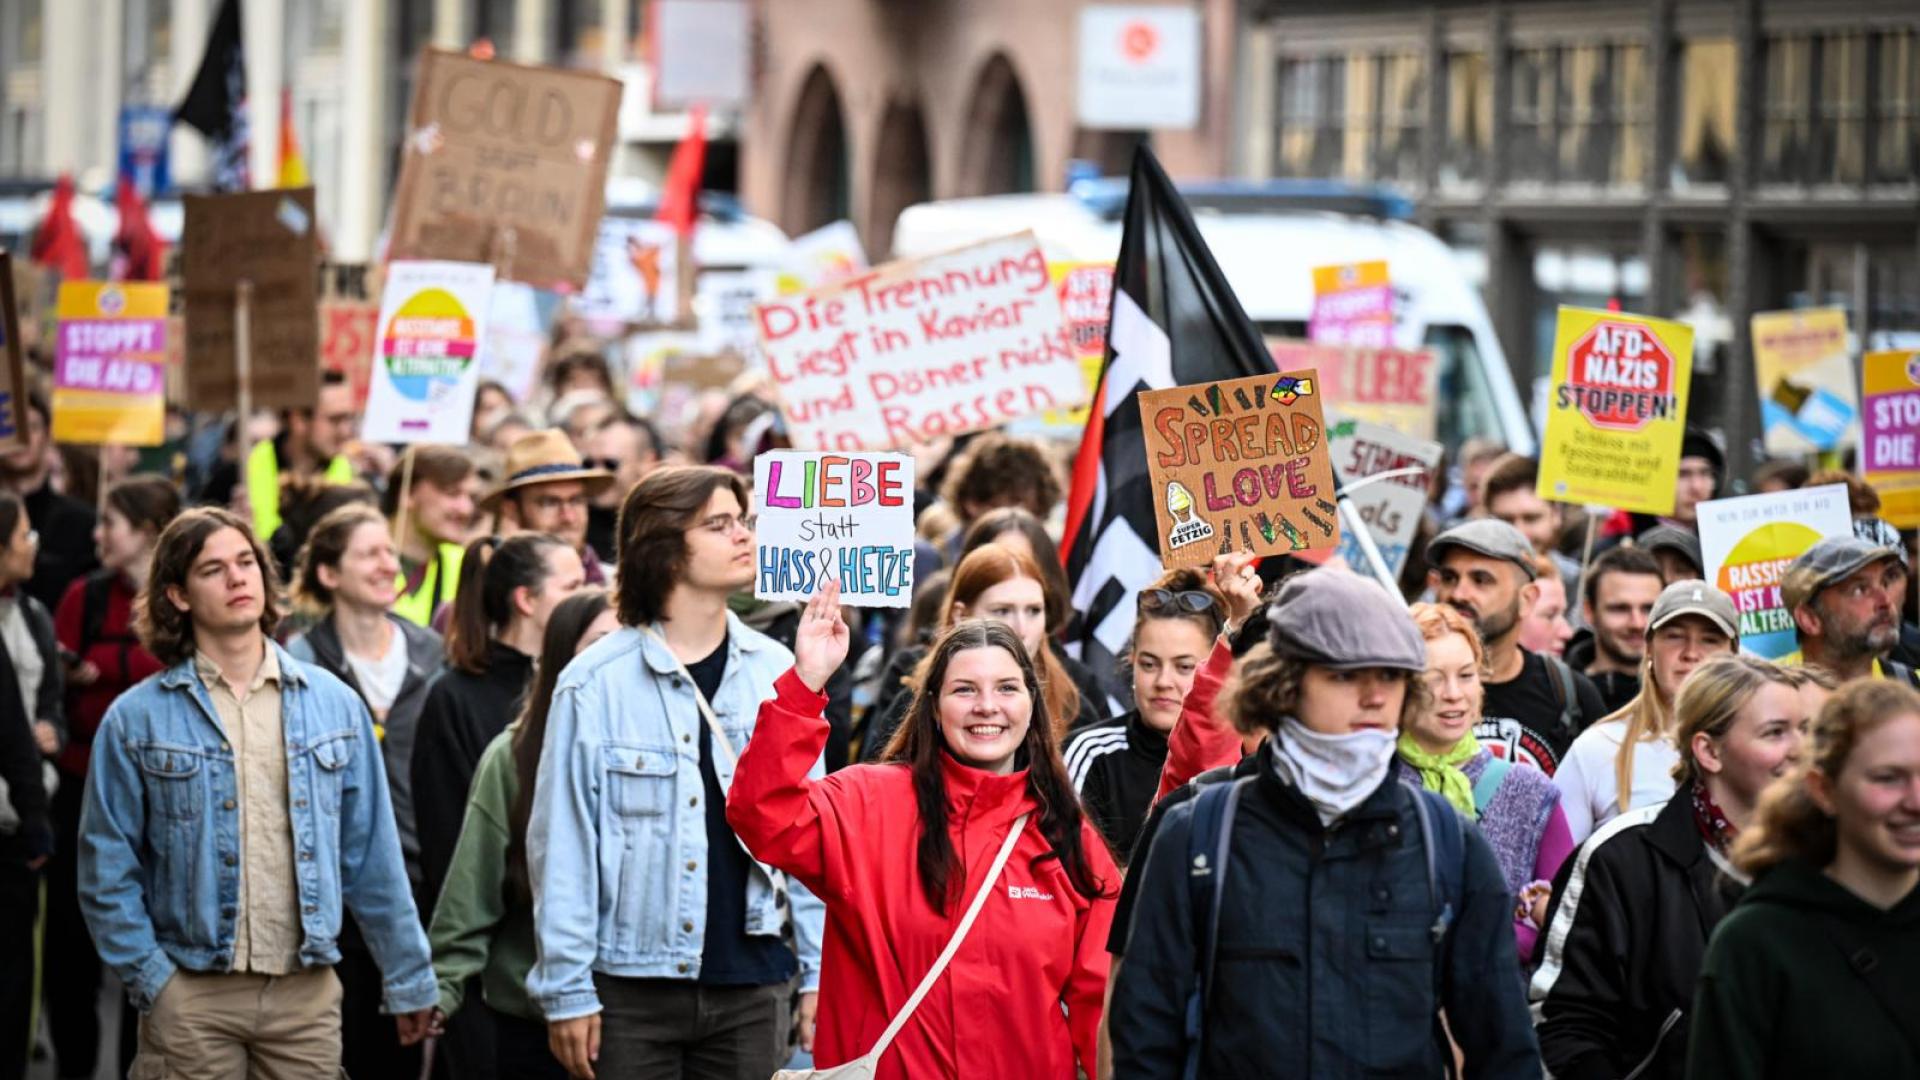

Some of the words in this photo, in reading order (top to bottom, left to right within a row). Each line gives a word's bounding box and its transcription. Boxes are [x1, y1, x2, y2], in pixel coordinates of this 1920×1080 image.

[437, 72, 575, 147] GOLD
[758, 295, 844, 341] Die
[844, 247, 1050, 316] Trennung
[67, 323, 155, 352] STOPPT
[869, 326, 910, 353] in
[917, 301, 1035, 343] Kaviar
[1592, 326, 1655, 359] AFD-
[65, 356, 101, 385] DIE
[104, 360, 154, 391] AFD
[787, 384, 854, 423] und
[869, 357, 988, 402] Döner
[1000, 327, 1075, 370] nicht
[1584, 354, 1660, 389] NAZIS
[816, 429, 864, 451] in
[881, 385, 1056, 445] Rassen
[1557, 384, 1678, 421] STOPPEN!
[1155, 407, 1319, 468] SPREAD
[1875, 434, 1915, 467] DIE
[767, 456, 904, 509] LIEBE
[1203, 457, 1317, 512] LOVE
[798, 512, 860, 542] statt
[1171, 525, 1211, 546] FETZIG
[1176, 521, 1201, 534] SUPER
[760, 545, 816, 594] HASS
[839, 545, 913, 596] HETZE
[1729, 558, 1792, 589] RASSIS
[1739, 588, 1764, 613] IST
